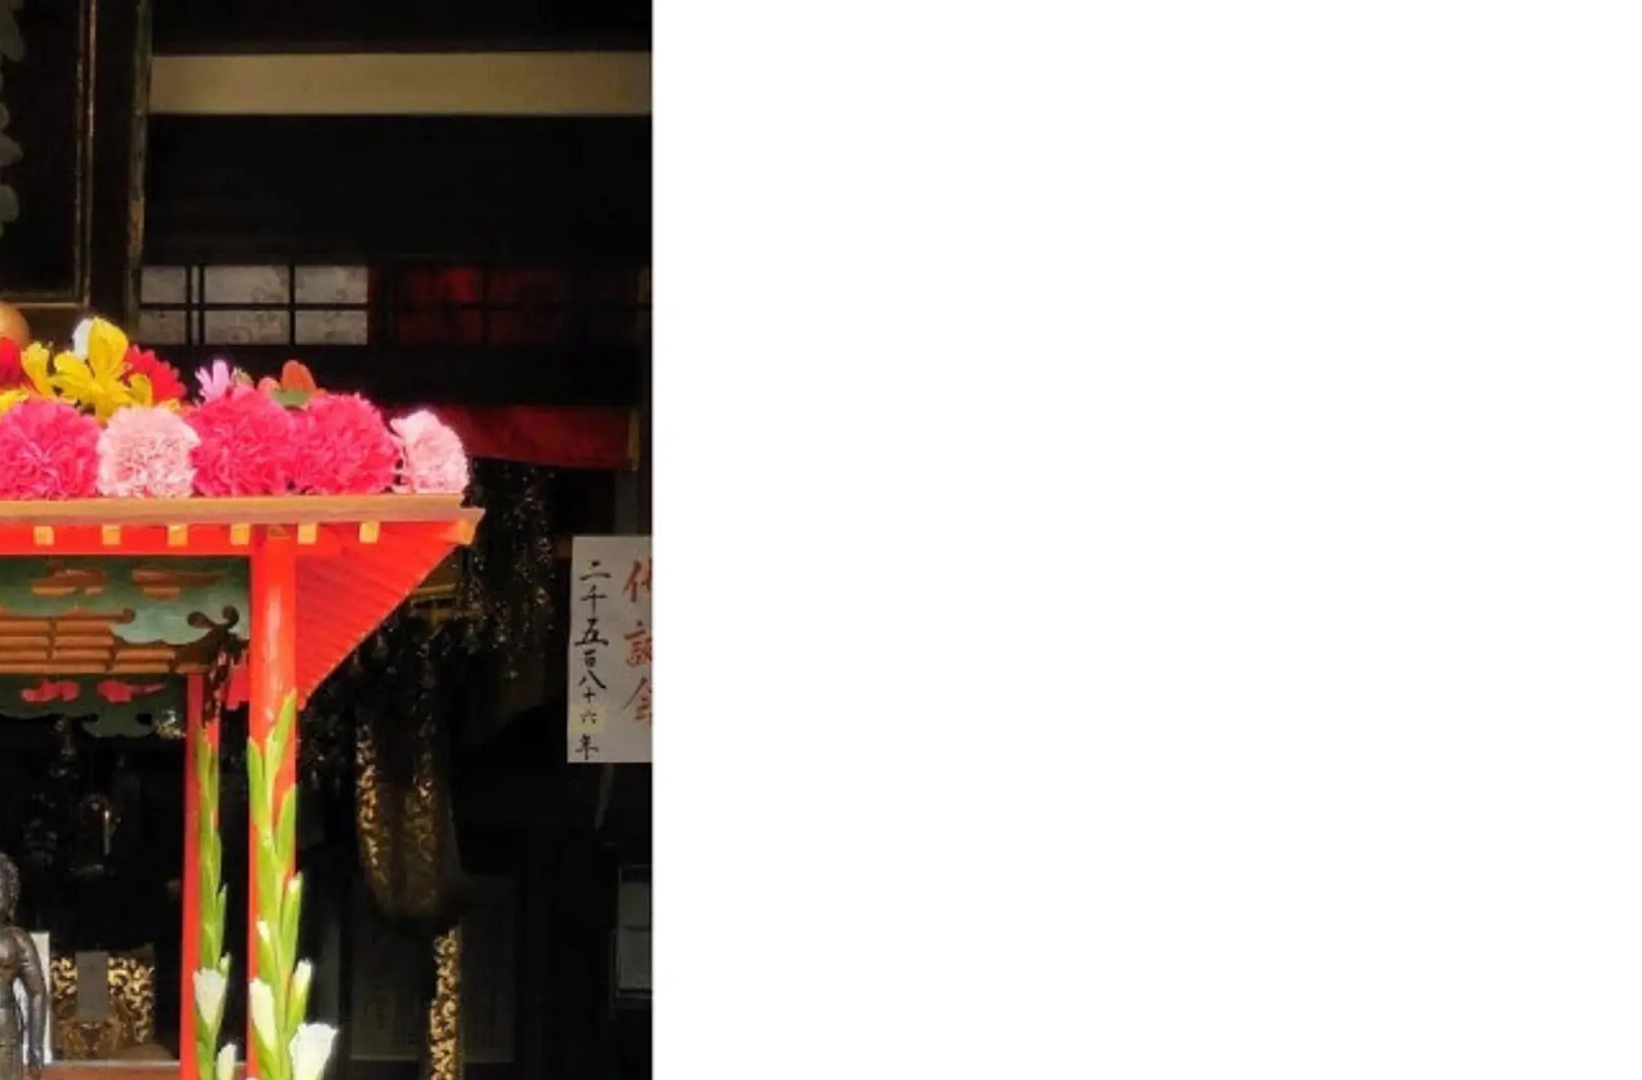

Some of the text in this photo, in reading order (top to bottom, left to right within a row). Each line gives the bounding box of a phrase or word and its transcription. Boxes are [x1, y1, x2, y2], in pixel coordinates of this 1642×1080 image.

[575, 561, 612, 761] 二千五百八十六年
